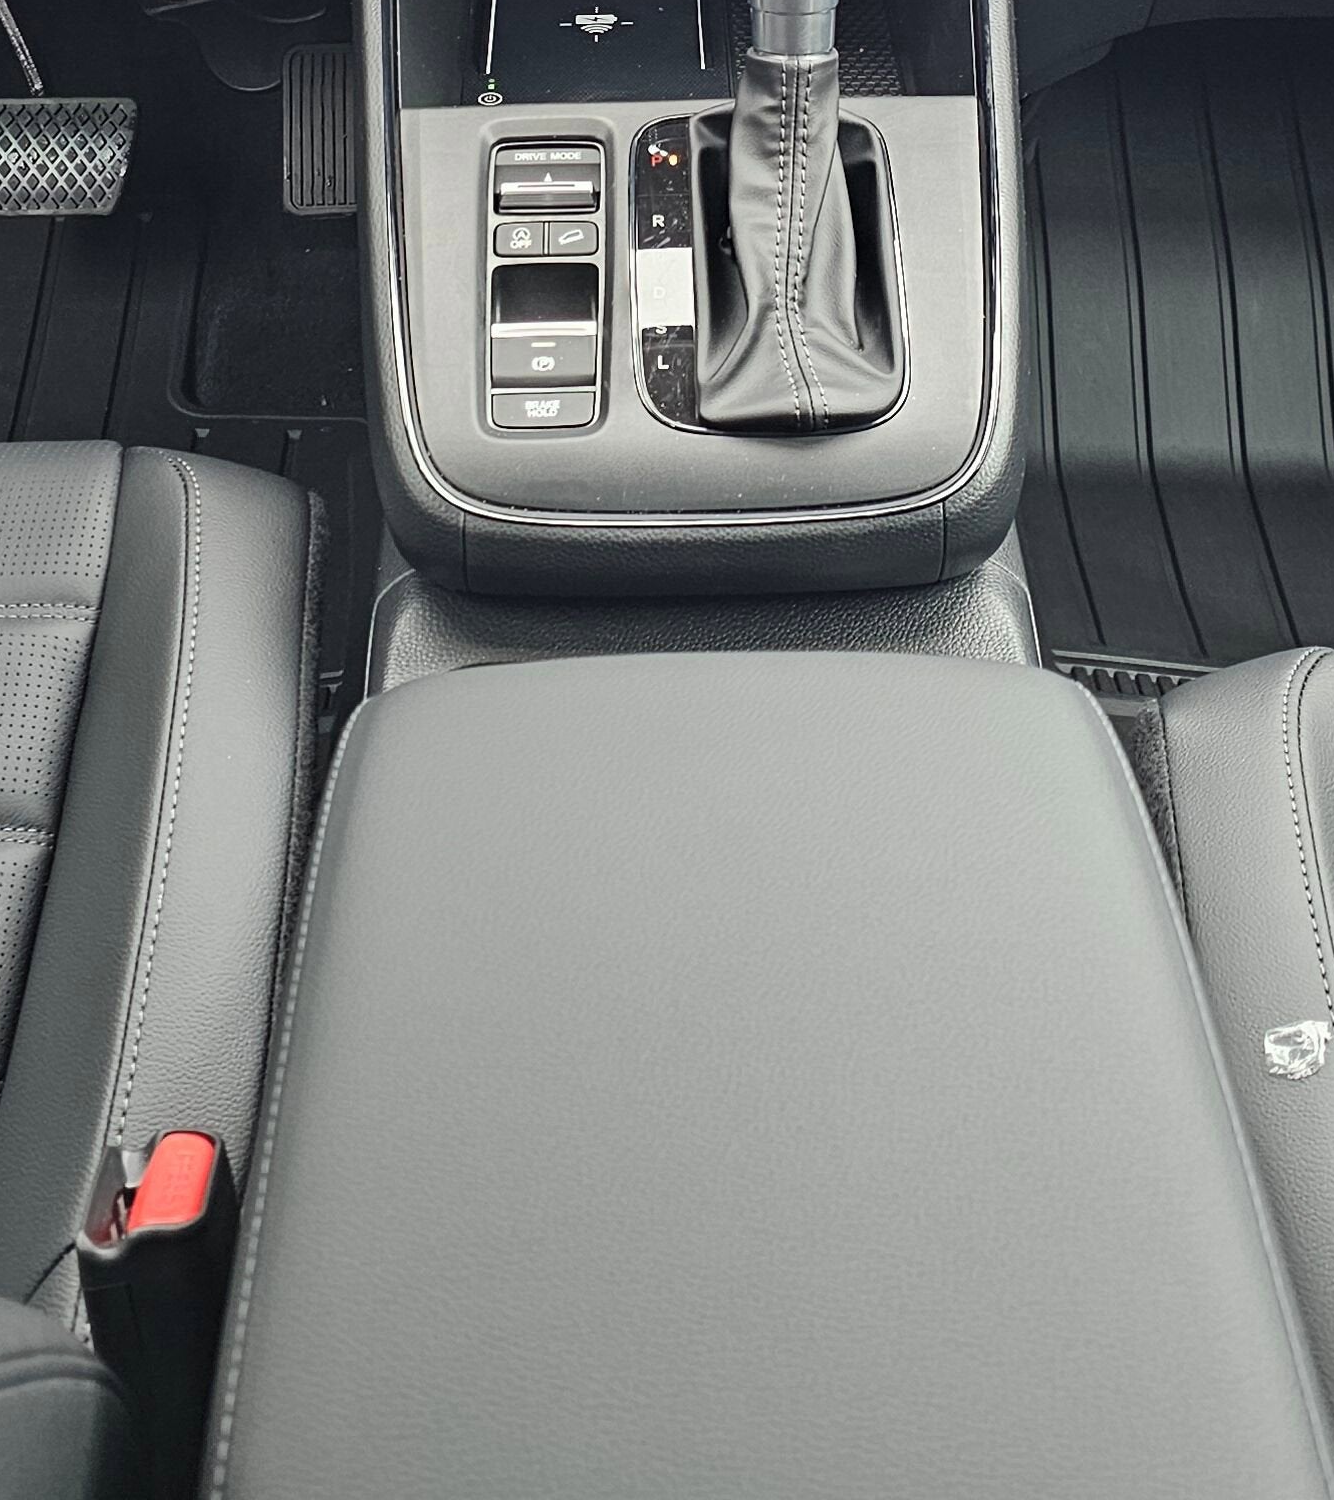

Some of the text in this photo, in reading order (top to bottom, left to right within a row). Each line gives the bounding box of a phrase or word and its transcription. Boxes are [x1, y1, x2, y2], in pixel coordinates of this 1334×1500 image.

[514, 151, 582, 161] DRIVE MODE
[651, 155, 663, 167] P
[652, 214, 665, 228] R
[510, 239, 532, 249] OFF
[657, 355, 670, 370] L
[527, 408, 558, 418] HOLD
